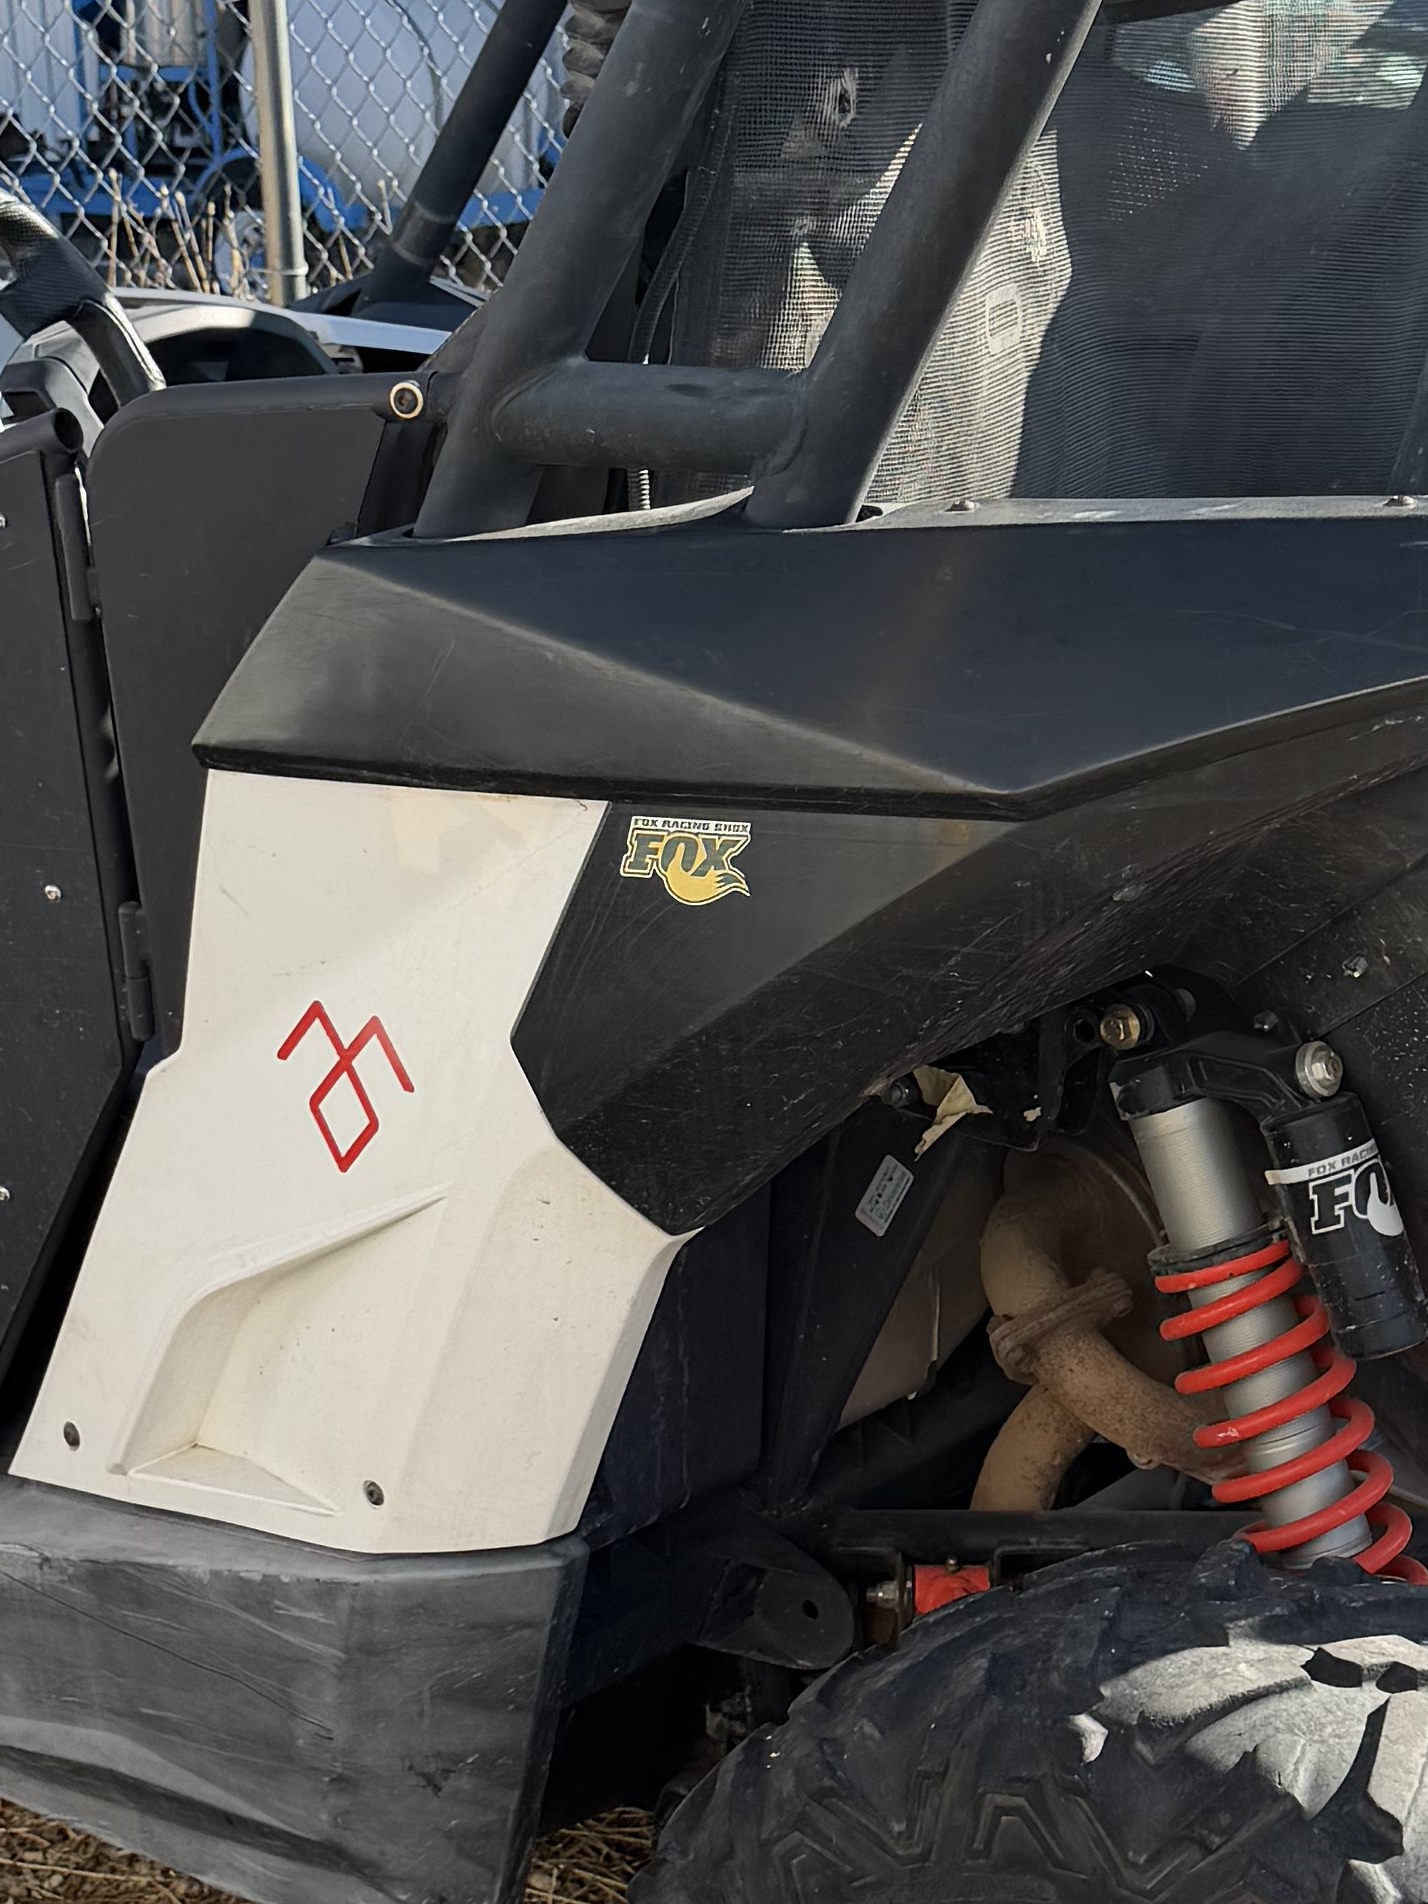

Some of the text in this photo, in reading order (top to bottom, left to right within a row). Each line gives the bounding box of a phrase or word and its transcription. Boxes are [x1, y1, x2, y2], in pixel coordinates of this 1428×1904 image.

[634, 818, 659, 828] FOX
[662, 820, 710, 831] RACING
[623, 830, 749, 881] FOX
[1308, 1160, 1337, 1178] FOX
[1308, 1159, 1397, 1235] FO
